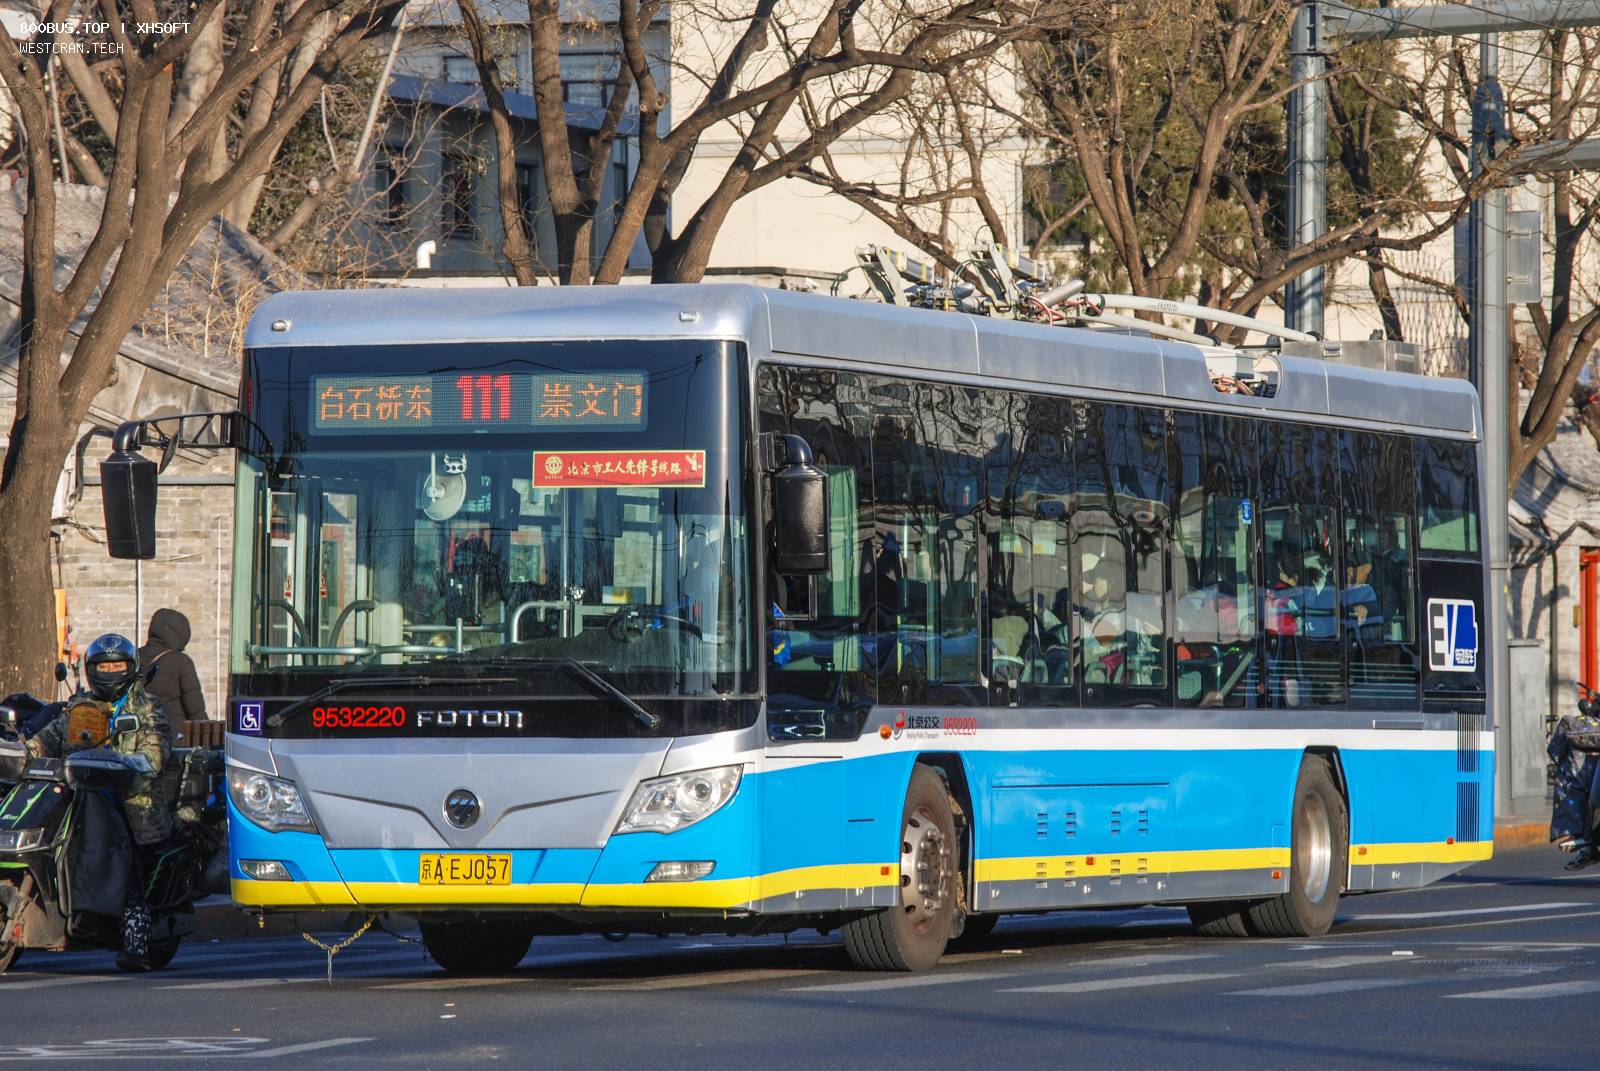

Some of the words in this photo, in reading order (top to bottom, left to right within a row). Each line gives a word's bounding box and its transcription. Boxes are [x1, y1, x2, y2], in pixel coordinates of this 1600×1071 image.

[320, 384, 432, 421] 白石桥东
[457, 374, 511, 420] 111
[540, 382, 643, 418] 崇文门
[567, 459, 682, 478] 北京市工人先锋号线路
[312, 706, 405, 728] 9532220
[417, 710, 523, 728] FOTON
[907, 716, 940, 729] 北京公交
[944, 717, 976, 736] 9532220
